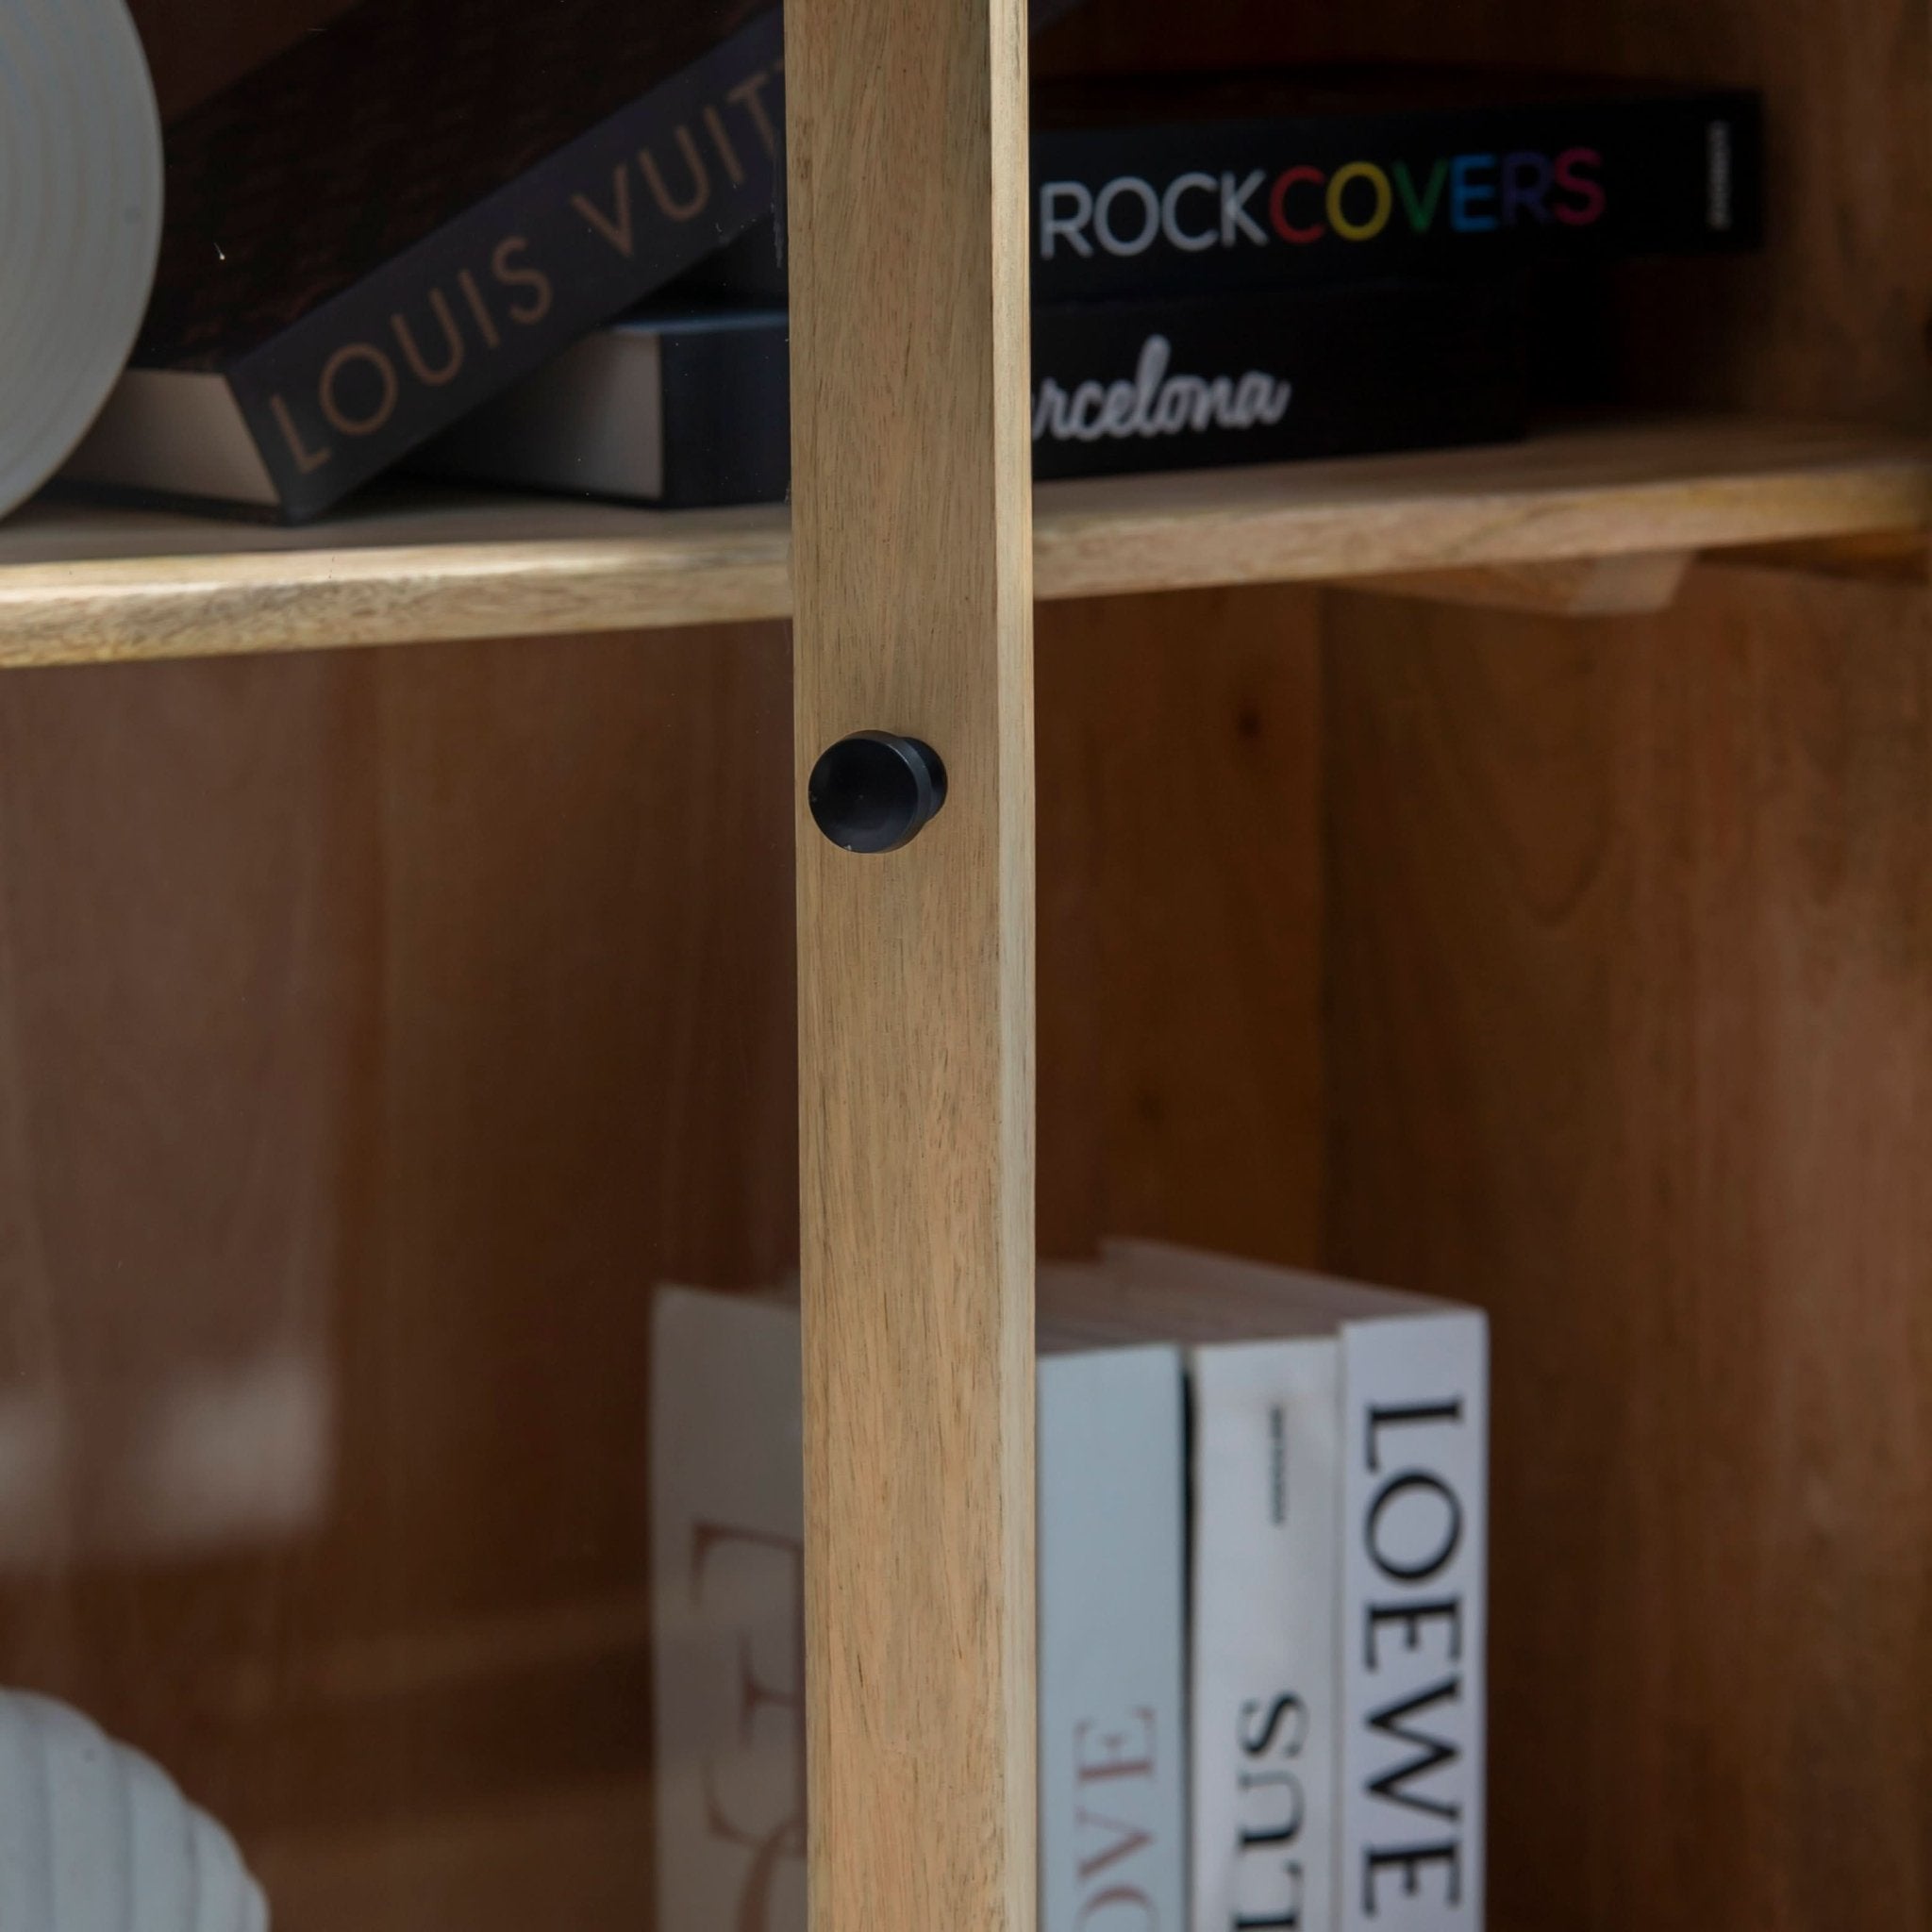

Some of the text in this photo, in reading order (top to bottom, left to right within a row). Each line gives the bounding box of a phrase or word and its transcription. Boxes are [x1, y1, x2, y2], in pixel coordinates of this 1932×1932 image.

[270, 60, 785, 474] LOUIS VUIT
[1031, 333, 1291, 441] rcelona
[1361, 1393, 1466, 1919] LOEWE
